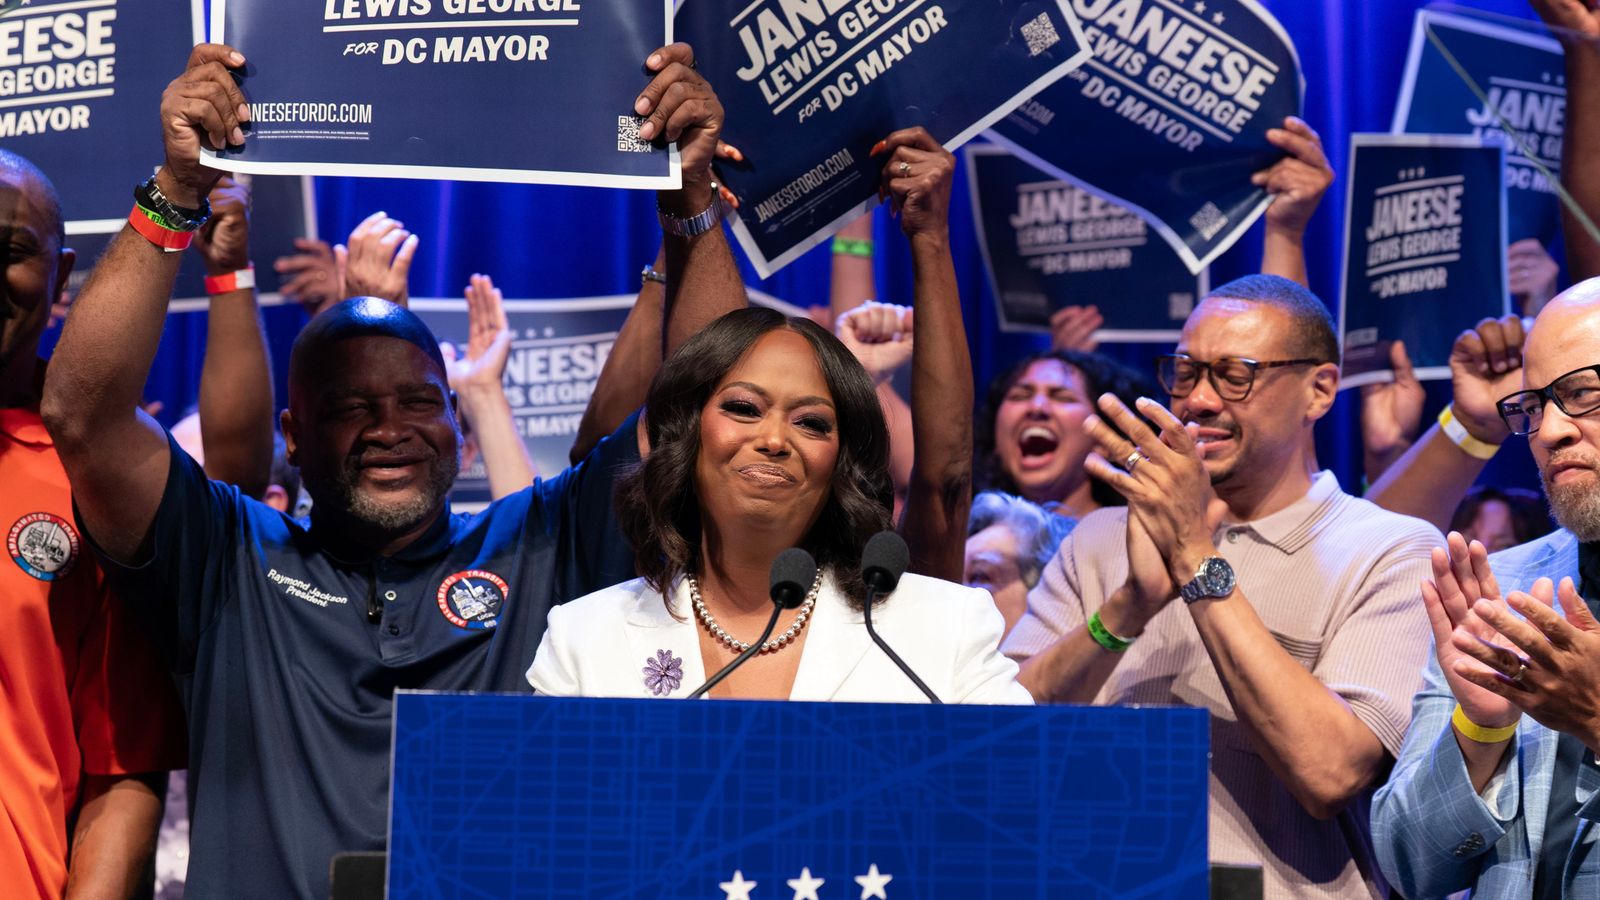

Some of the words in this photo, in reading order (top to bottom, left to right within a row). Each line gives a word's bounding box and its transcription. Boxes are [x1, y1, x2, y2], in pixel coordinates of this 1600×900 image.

[324, 0, 432, 20] LEWIS
[343, 42, 379, 56] FOR
[382, 38, 427, 65] DC
[433, 35, 550, 63] MAYOR
[736, 0, 852, 82] JAN
[0, 57, 116, 96] GEORGE
[758, 30, 838, 106] LEWIS
[798, 97, 822, 123] FOR
[821, 72, 859, 112] DC
[855, 5, 948, 86] MAYOR
[1081, 22, 1147, 77] EWIS
[1147, 65, 1252, 133] GEORGE
[0, 105, 91, 138] MAYOR
[247, 103, 372, 123] NEESEFORDC.COM
[1081, 76, 1121, 107] DC
[1115, 95, 1204, 152] MAYOR
[755, 148, 855, 223] JANEESEFORDC.COM
[1010, 187, 1128, 229] JANEE
[1366, 185, 1464, 242] JANEESE
[1402, 226, 1461, 258] GEORGE
[1398, 266, 1448, 295] MAYOR
[502, 342, 614, 385] NEES
[267, 568, 310, 592] Raymond
[309, 587, 348, 604] Jackson
[285, 585, 328, 607] President
[467, 569, 502, 585] TRANSIT
